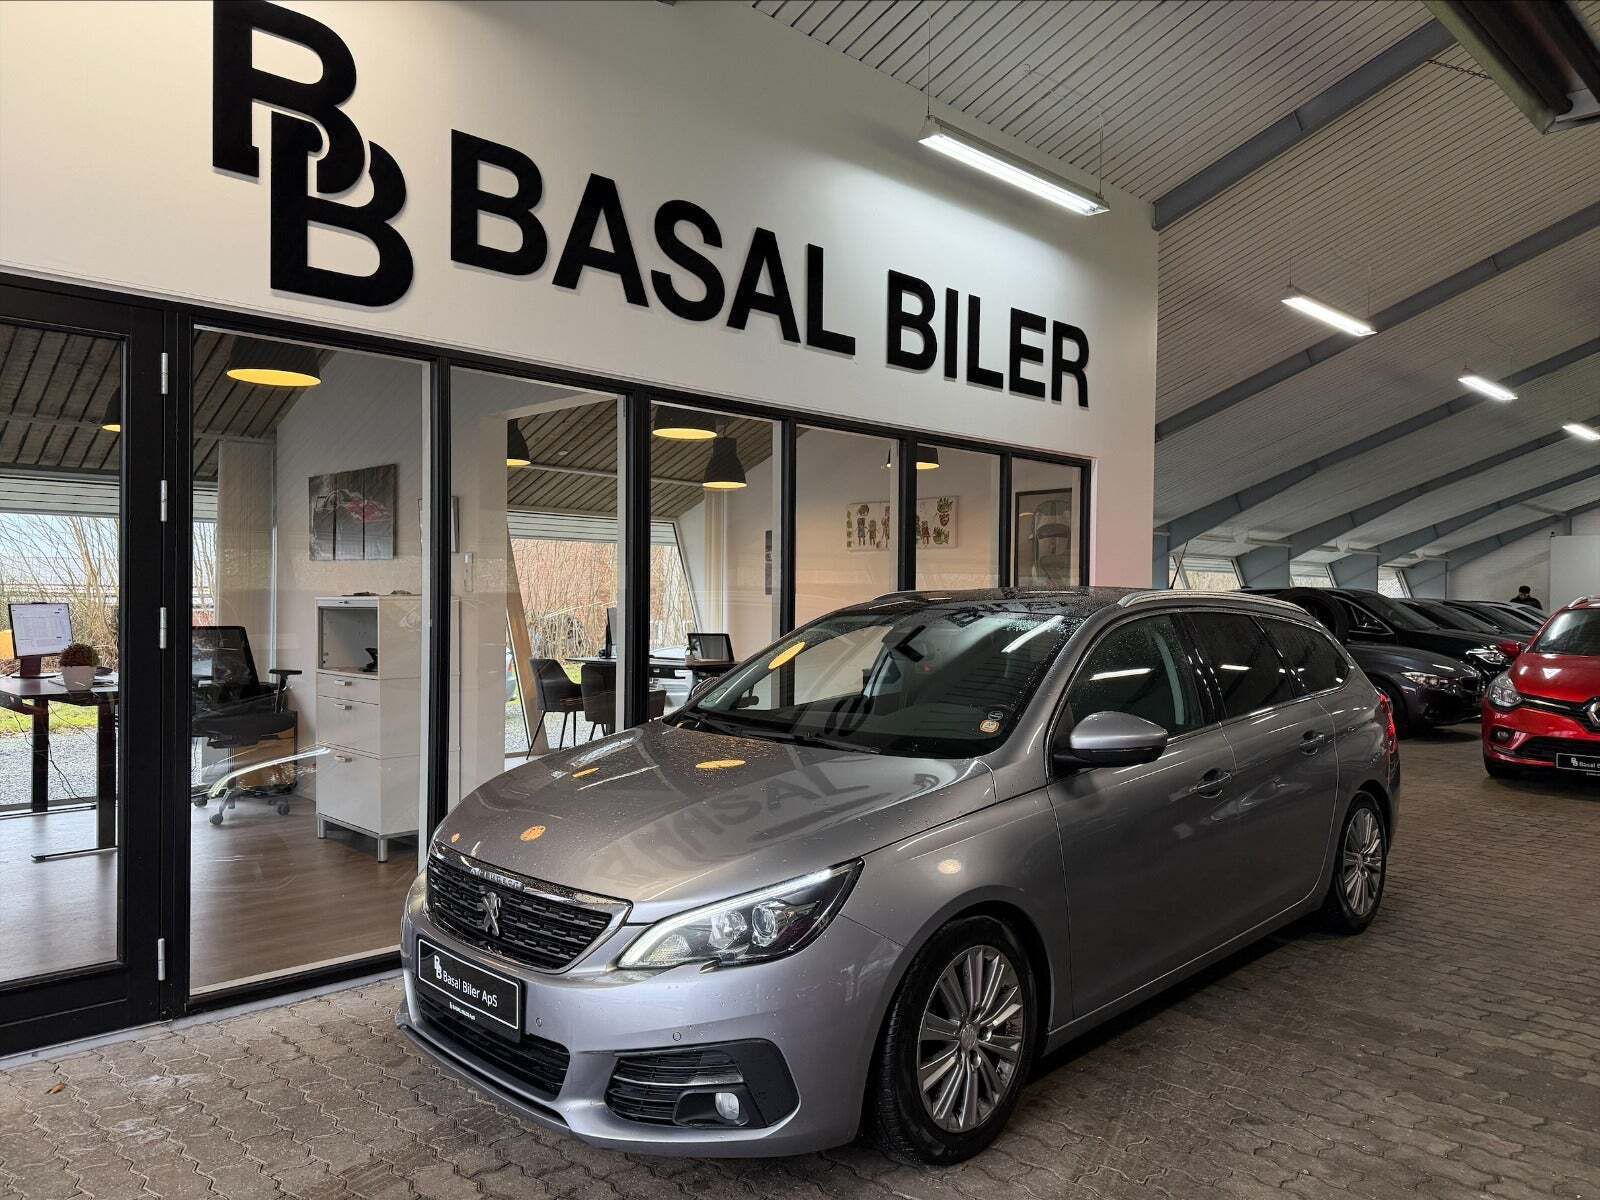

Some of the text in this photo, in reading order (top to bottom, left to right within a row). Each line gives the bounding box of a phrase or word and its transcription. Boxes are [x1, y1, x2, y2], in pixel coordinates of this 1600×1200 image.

[450, 128, 1090, 408] BASAL BILER
[443, 970, 461, 990] Basal
[462, 981, 481, 999] Biler
[481, 990, 498, 1008] ApS
